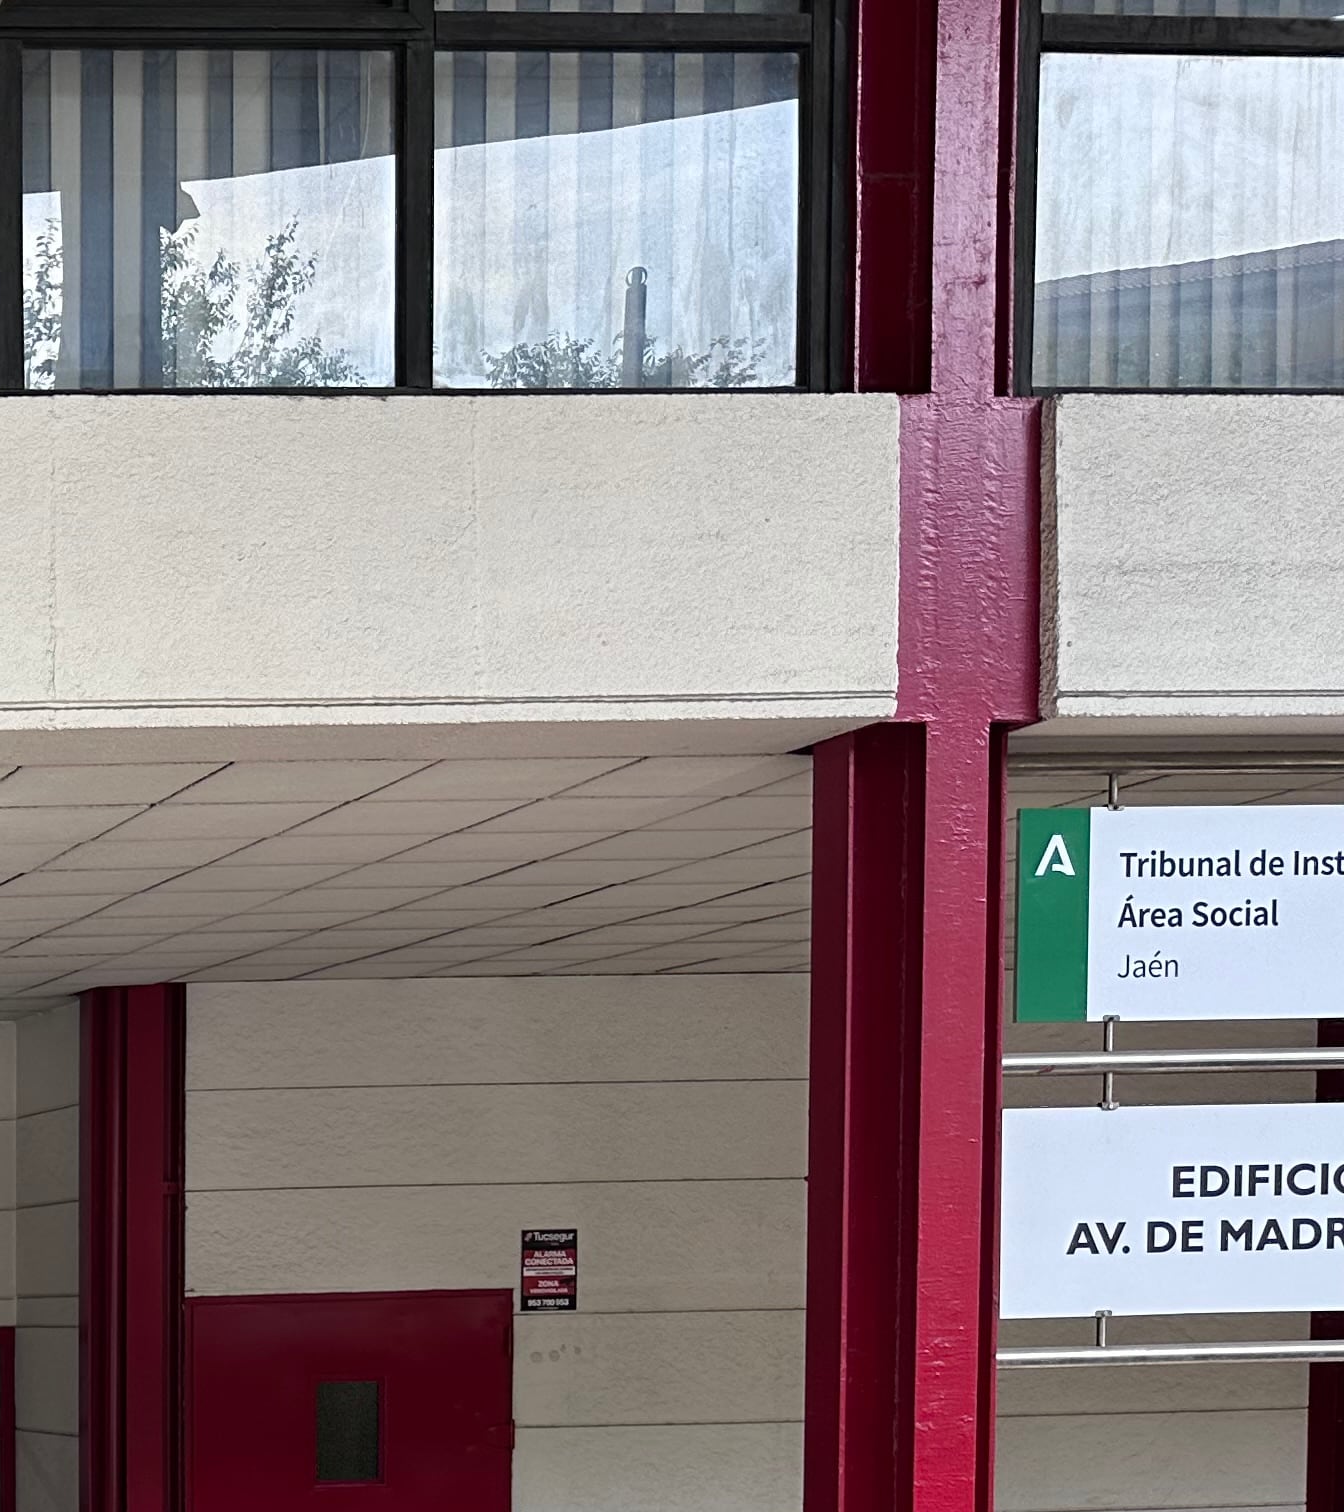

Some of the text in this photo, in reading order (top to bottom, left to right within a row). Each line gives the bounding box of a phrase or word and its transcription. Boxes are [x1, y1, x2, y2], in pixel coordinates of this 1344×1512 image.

[1119, 849, 1241, 878] Tribunal
[1249, 849, 1284, 876] de
[1117, 894, 1279, 928] Área Social
[1117, 950, 1179, 978] Jaén
[533, 1232, 574, 1242] Tucsegur
[1066, 1221, 1130, 1255] AV.
[1146, 1220, 1204, 1254] DE
[525, 1258, 574, 1266] CONECTADA
